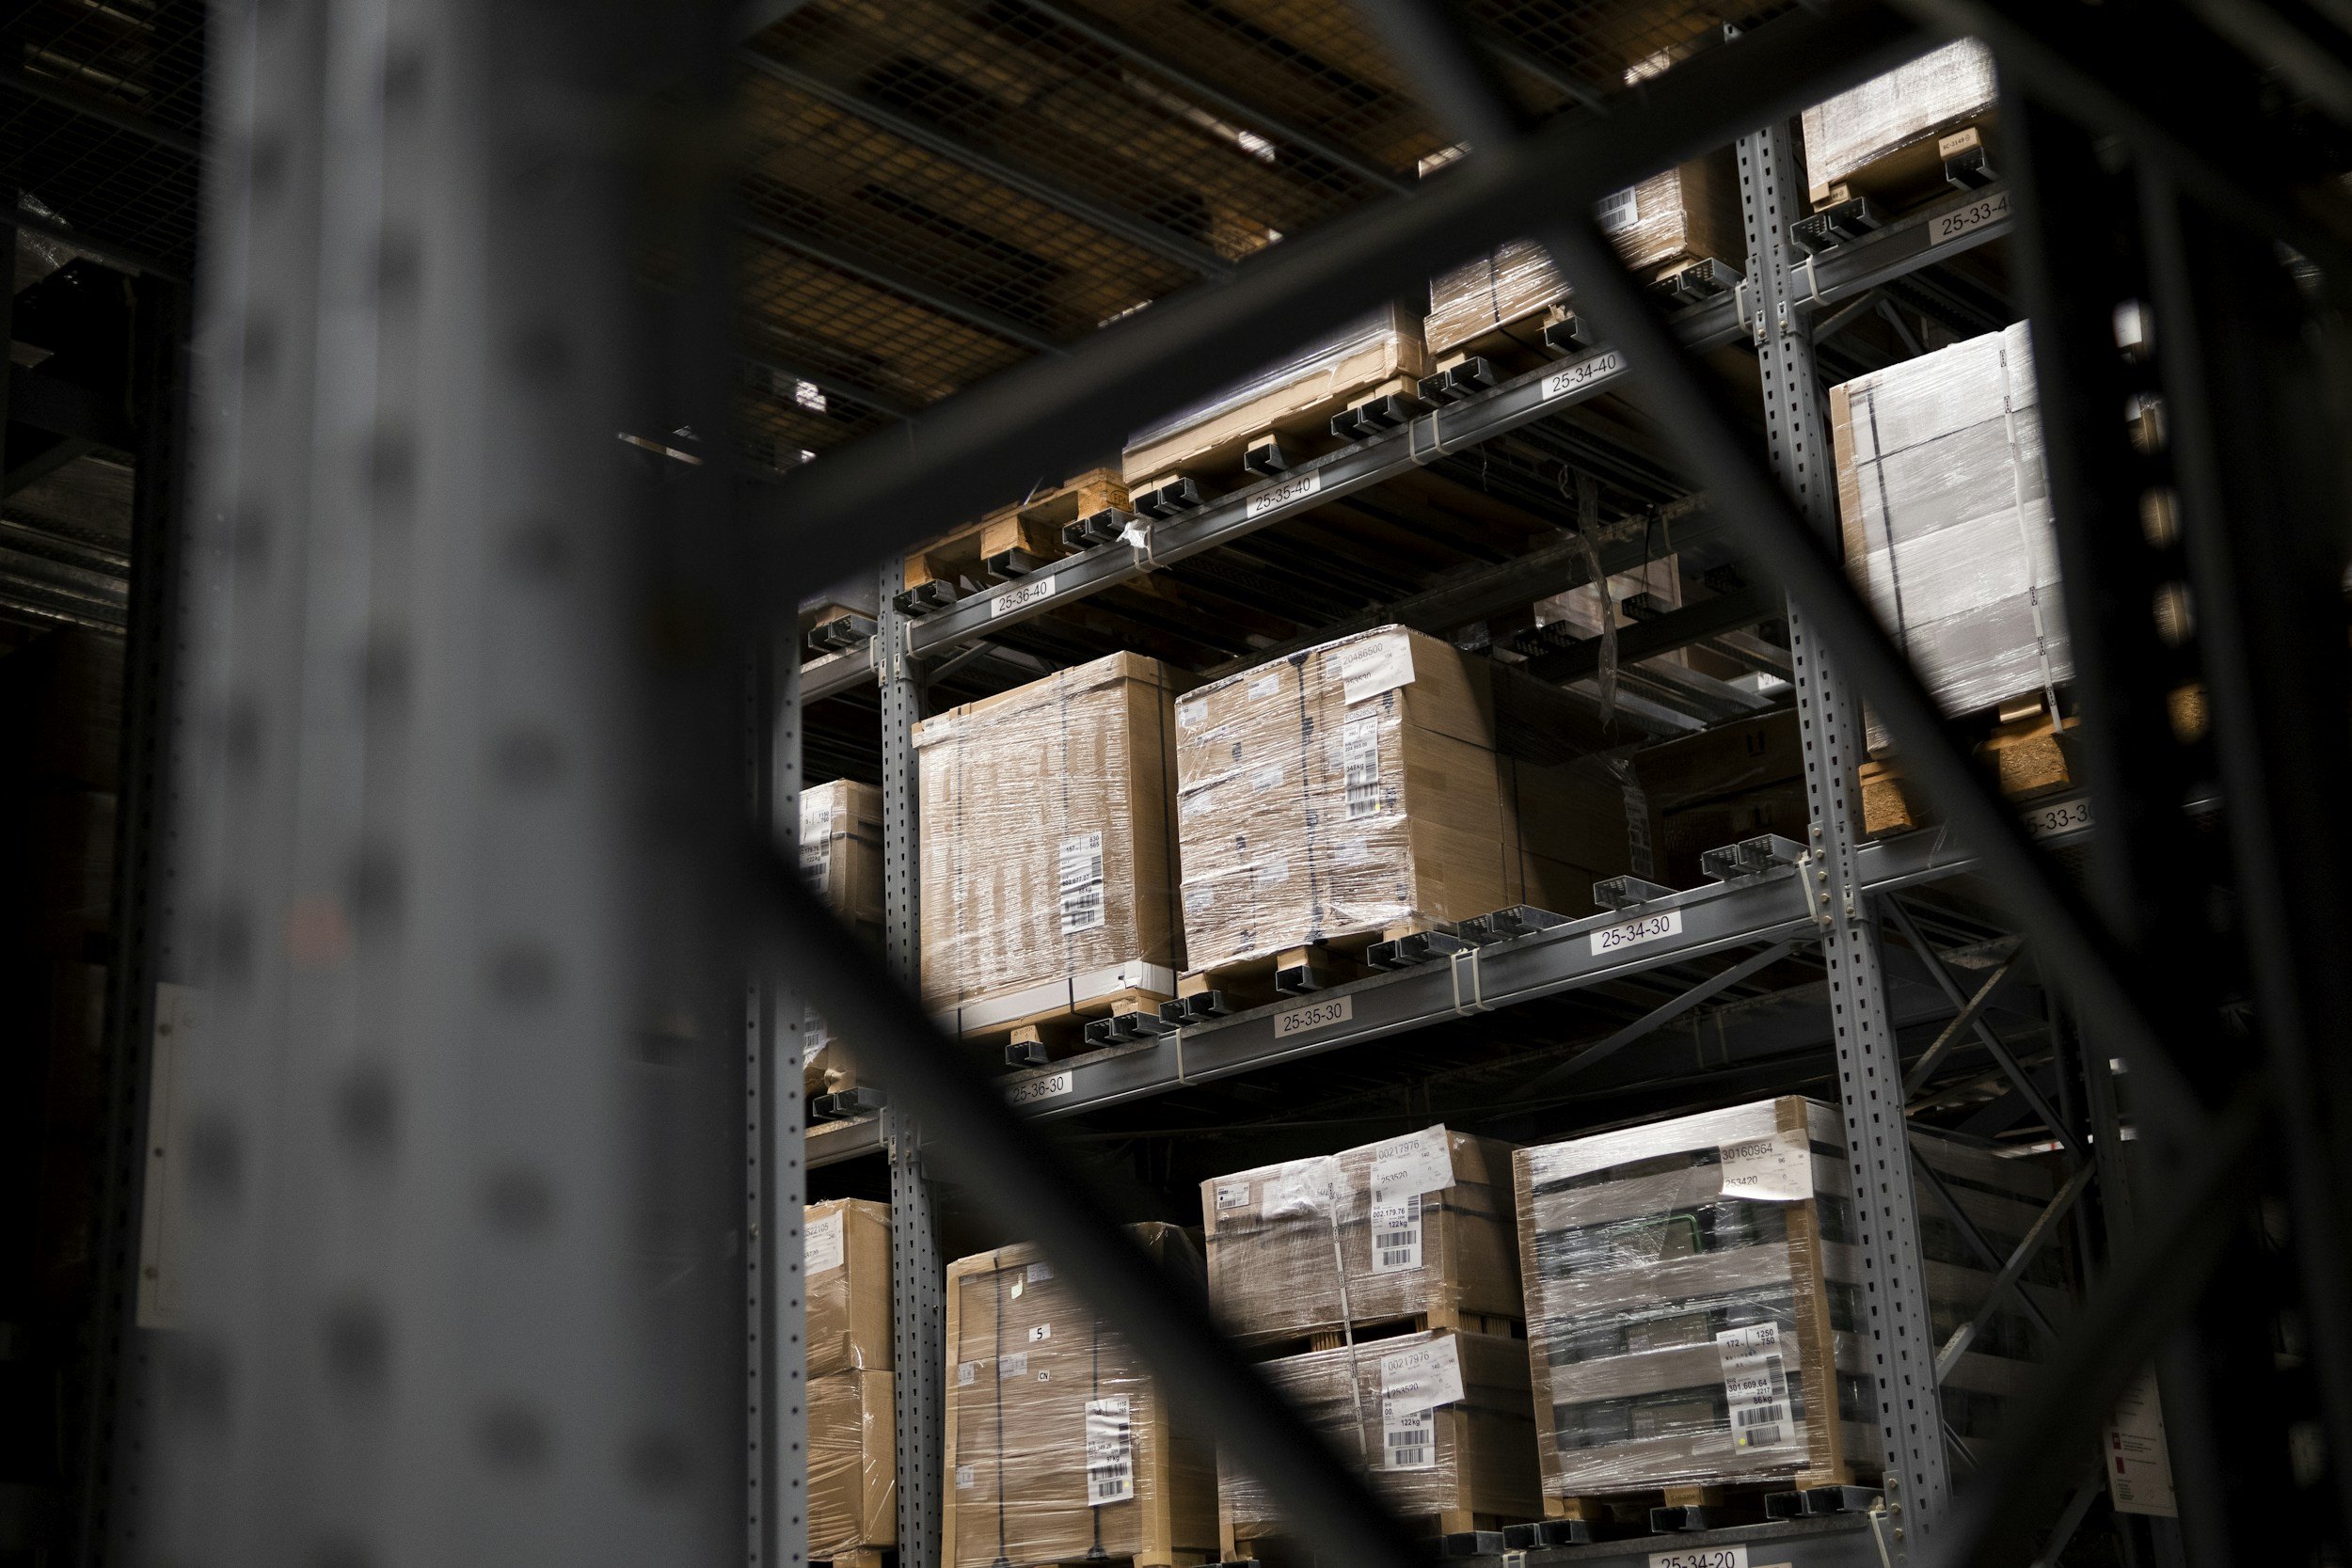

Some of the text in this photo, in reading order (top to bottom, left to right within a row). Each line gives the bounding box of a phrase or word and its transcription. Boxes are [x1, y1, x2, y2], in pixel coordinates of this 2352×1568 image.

[1942, 194, 2013, 235] 25-33-4
[1552, 354, 1616, 392] 25-34-40
[1255, 477, 1311, 511] 25-35-40
[999, 581, 1047, 611] 25-36-40
[1343, 642, 1383, 666] 20486500
[2026, 804, 2092, 835] 5-33-3
[1601, 915, 1670, 948] 25-34-30
[1283, 1003, 1343, 1032] 25-35-30
[1012, 1076, 1064, 1102] 25-36-30
[1378, 1139, 1420, 1160] 00217976
[1722, 1142, 1773, 1161] 30160964
[1724, 1175, 1758, 1188] 253420
[1373, 1207, 1406, 1218] 002.179.76
[1389, 1220, 1407, 1228] 122kg
[1037, 1327, 1043, 1340] 5
[1756, 1328, 1774, 1338] 1250
[1726, 1338, 1740, 1349] 172
[1761, 1337, 1775, 1346] 750
[1388, 1350, 1430, 1371] 00217976
[1039, 1371, 1048, 1380] CN
[1728, 1378, 1768, 1392] 301.609.64
[1756, 1386, 1771, 1395] 2217
[1753, 1396, 1773, 1404] 86kg
[1401, 1418, 1421, 1427] 122kg
[1661, 1552, 1735, 1568] 25-34-20
